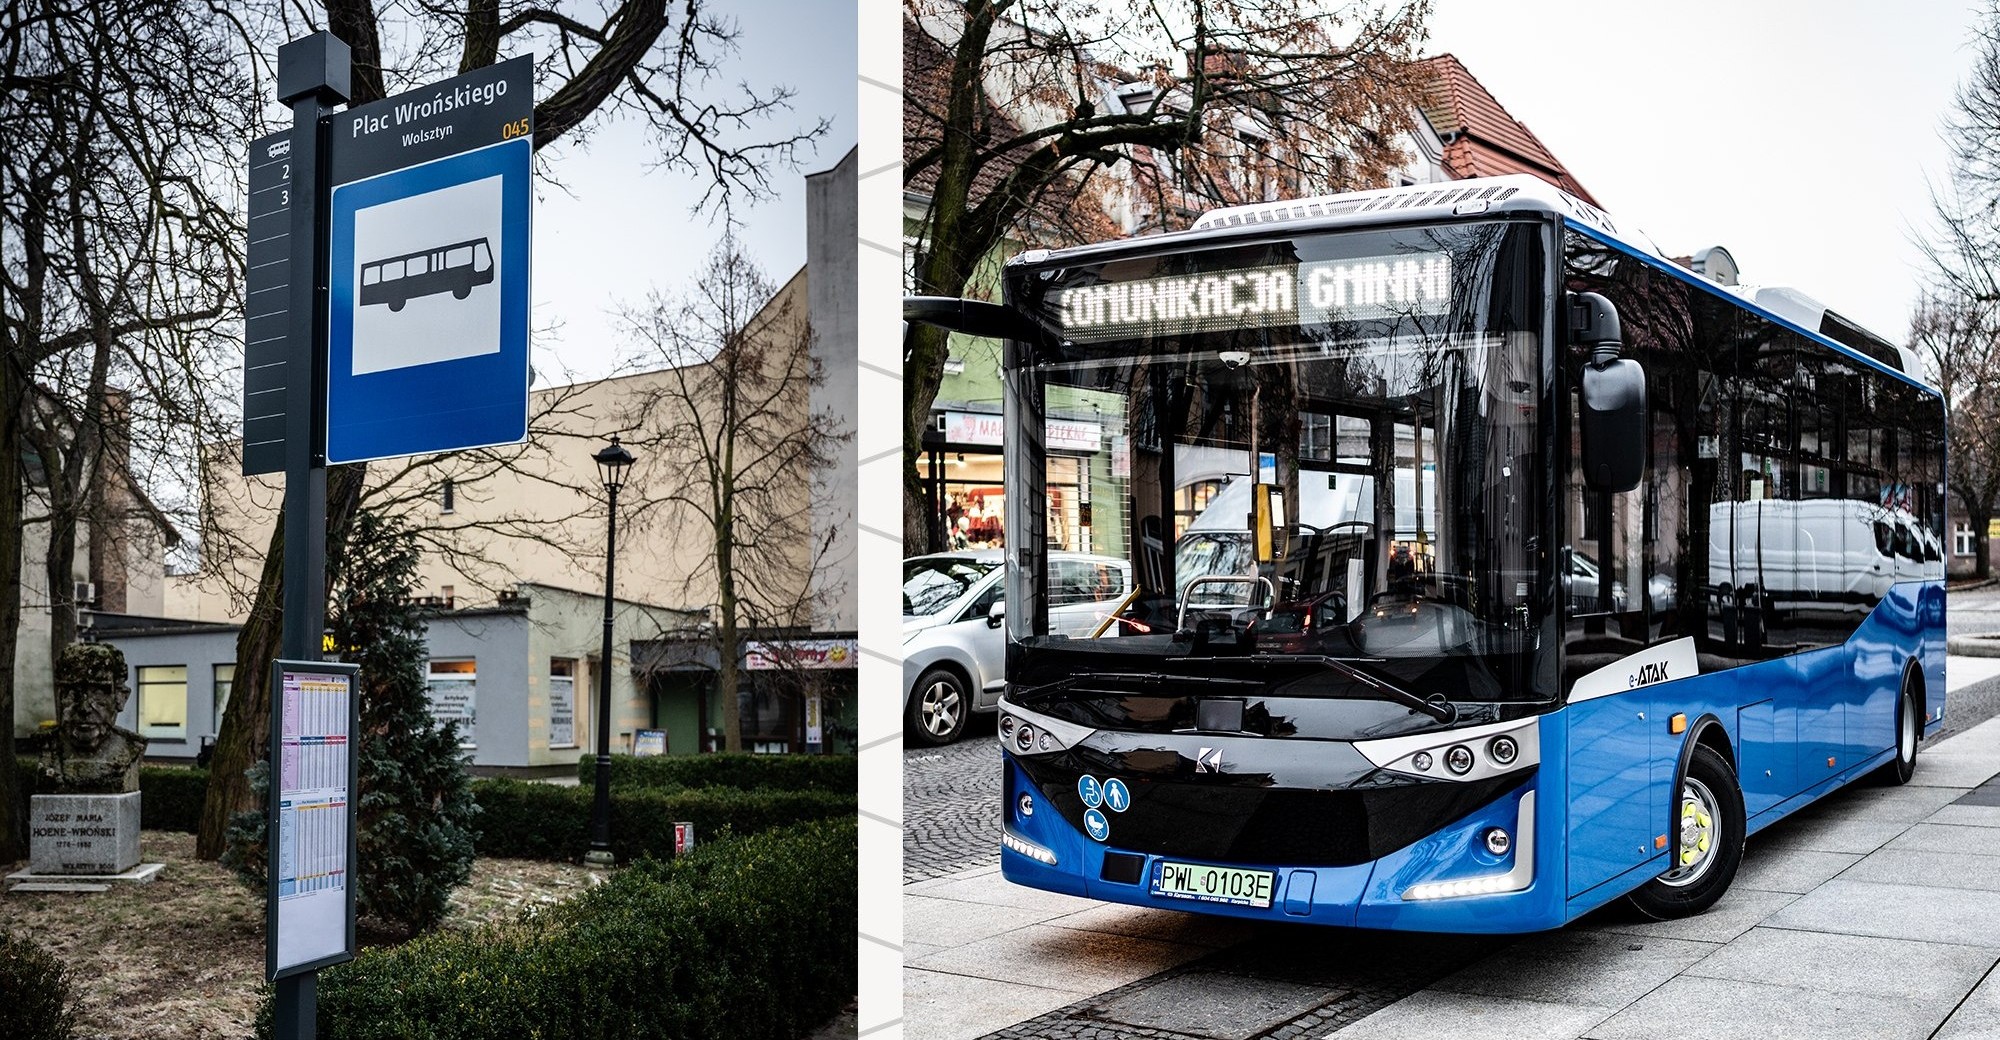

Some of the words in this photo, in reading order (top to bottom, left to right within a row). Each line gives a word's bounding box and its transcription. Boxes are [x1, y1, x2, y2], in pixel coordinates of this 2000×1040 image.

[353, 112, 389, 138] Plac
[394, 78, 508, 126] Wrońskiego
[401, 123, 453, 148] Wolsztyn
[502, 117, 530, 141] 045
[281, 164, 290, 180] 2
[280, 189, 289, 206] 3
[1628, 660, 1669, 688] e-ATAK
[45, 812, 71, 823] JÓZEF
[76, 813, 103, 823] MARIA
[33, 825, 116, 838] HOENE-WROŃSKI
[1152, 878, 1160, 887] PL
[1161, 865, 1198, 892] PWL
[1205, 869, 1270, 900] 0103E
